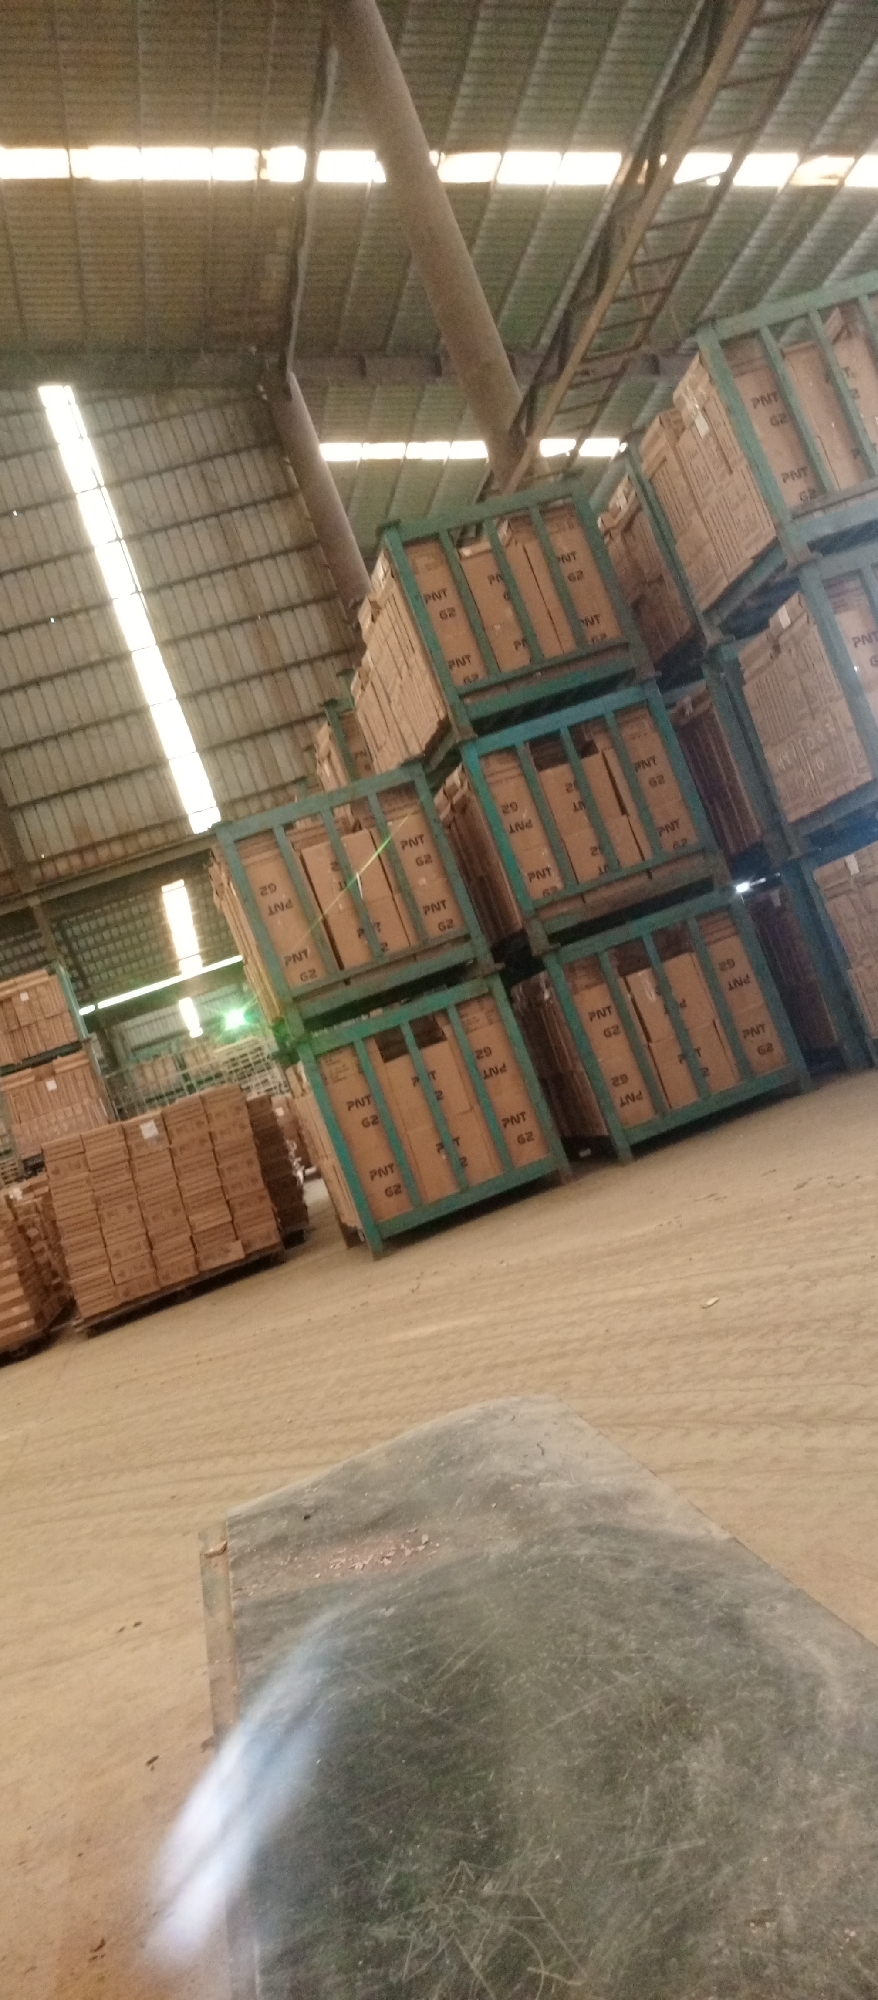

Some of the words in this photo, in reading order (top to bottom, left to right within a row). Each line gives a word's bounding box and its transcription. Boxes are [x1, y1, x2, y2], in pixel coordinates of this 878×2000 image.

[752, 391, 779, 409] PNT
[780, 466, 808, 483] PNT
[568, 570, 584, 582] G2
[424, 588, 447, 604] PNT
[439, 607, 456, 620] G2
[449, 654, 472, 670] PNT
[634, 756, 657, 772] PNT
[501, 801, 518, 815] G2
[509, 819, 533, 834] PNT
[658, 820, 681, 837] PNT
[401, 834, 424, 850] PNT
[415, 854, 433, 867] G2
[527, 866, 551, 882] PNT
[260, 883, 277, 896] G2
[267, 899, 293, 916] PNT
[422, 900, 446, 916] PNT
[438, 919, 454, 932] G2
[284, 948, 309, 966] PNT
[300, 969, 316, 981] G2
[728, 974, 751, 991] PNT
[588, 1006, 612, 1022] PNT
[742, 1023, 766, 1039] PNT
[475, 1047, 492, 1060] G2
[483, 1064, 507, 1080] PNT
[611, 1074, 629, 1087] G2
[347, 1094, 371, 1111] PNT
[619, 1091, 643, 1108] PNT
[362, 1115, 379, 1128] G2
[502, 1112, 527, 1128] PNT
[369, 1163, 395, 1181] PNT
[385, 1185, 401, 1197] G2
